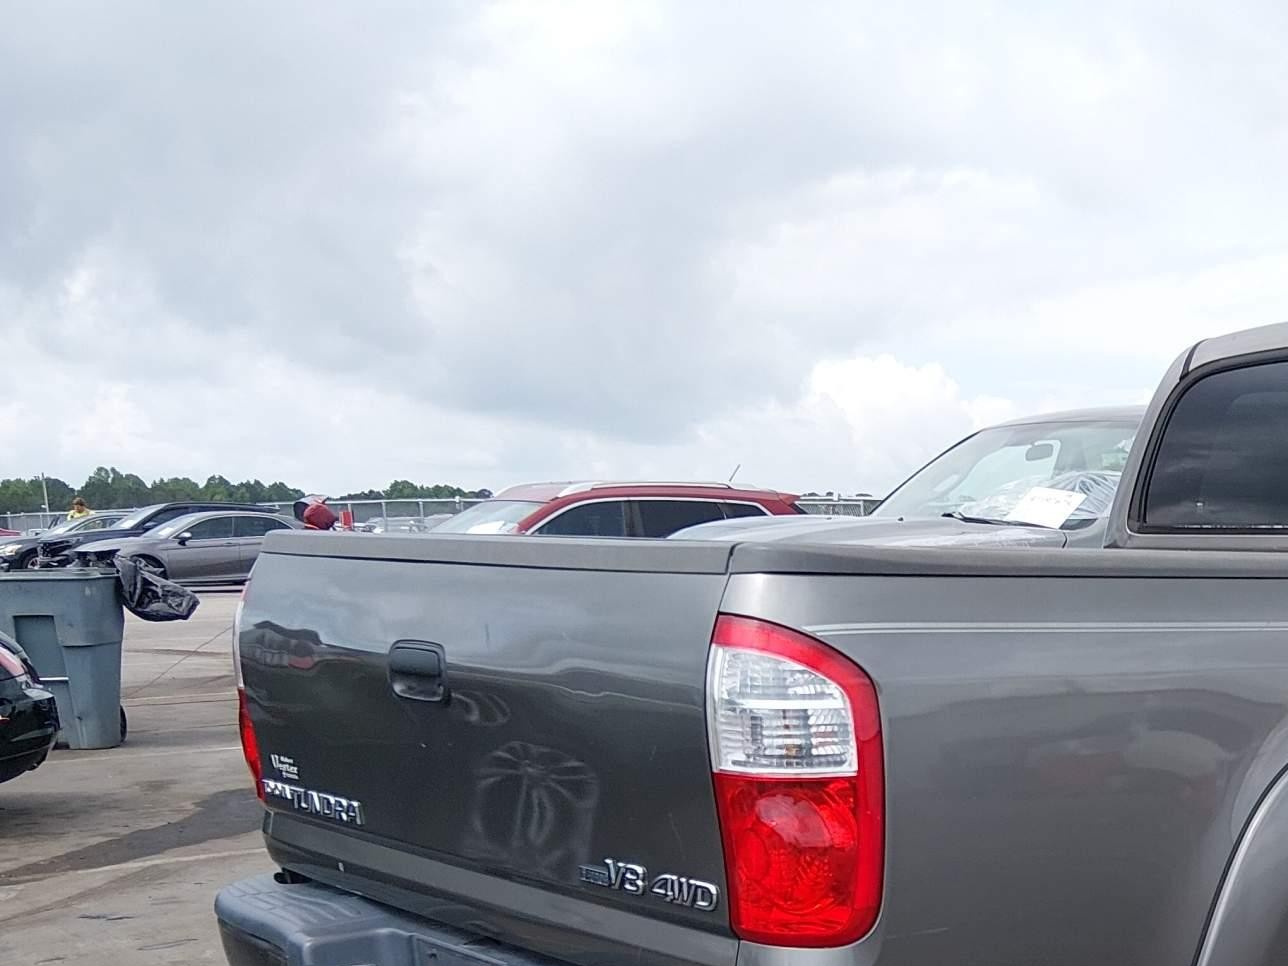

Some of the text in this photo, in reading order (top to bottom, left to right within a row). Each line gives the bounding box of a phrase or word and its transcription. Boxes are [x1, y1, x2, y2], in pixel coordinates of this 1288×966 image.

[289, 786, 366, 826] TUNDRA
[604, 858, 648, 896] V8
[650, 873, 720, 912] 4WD
